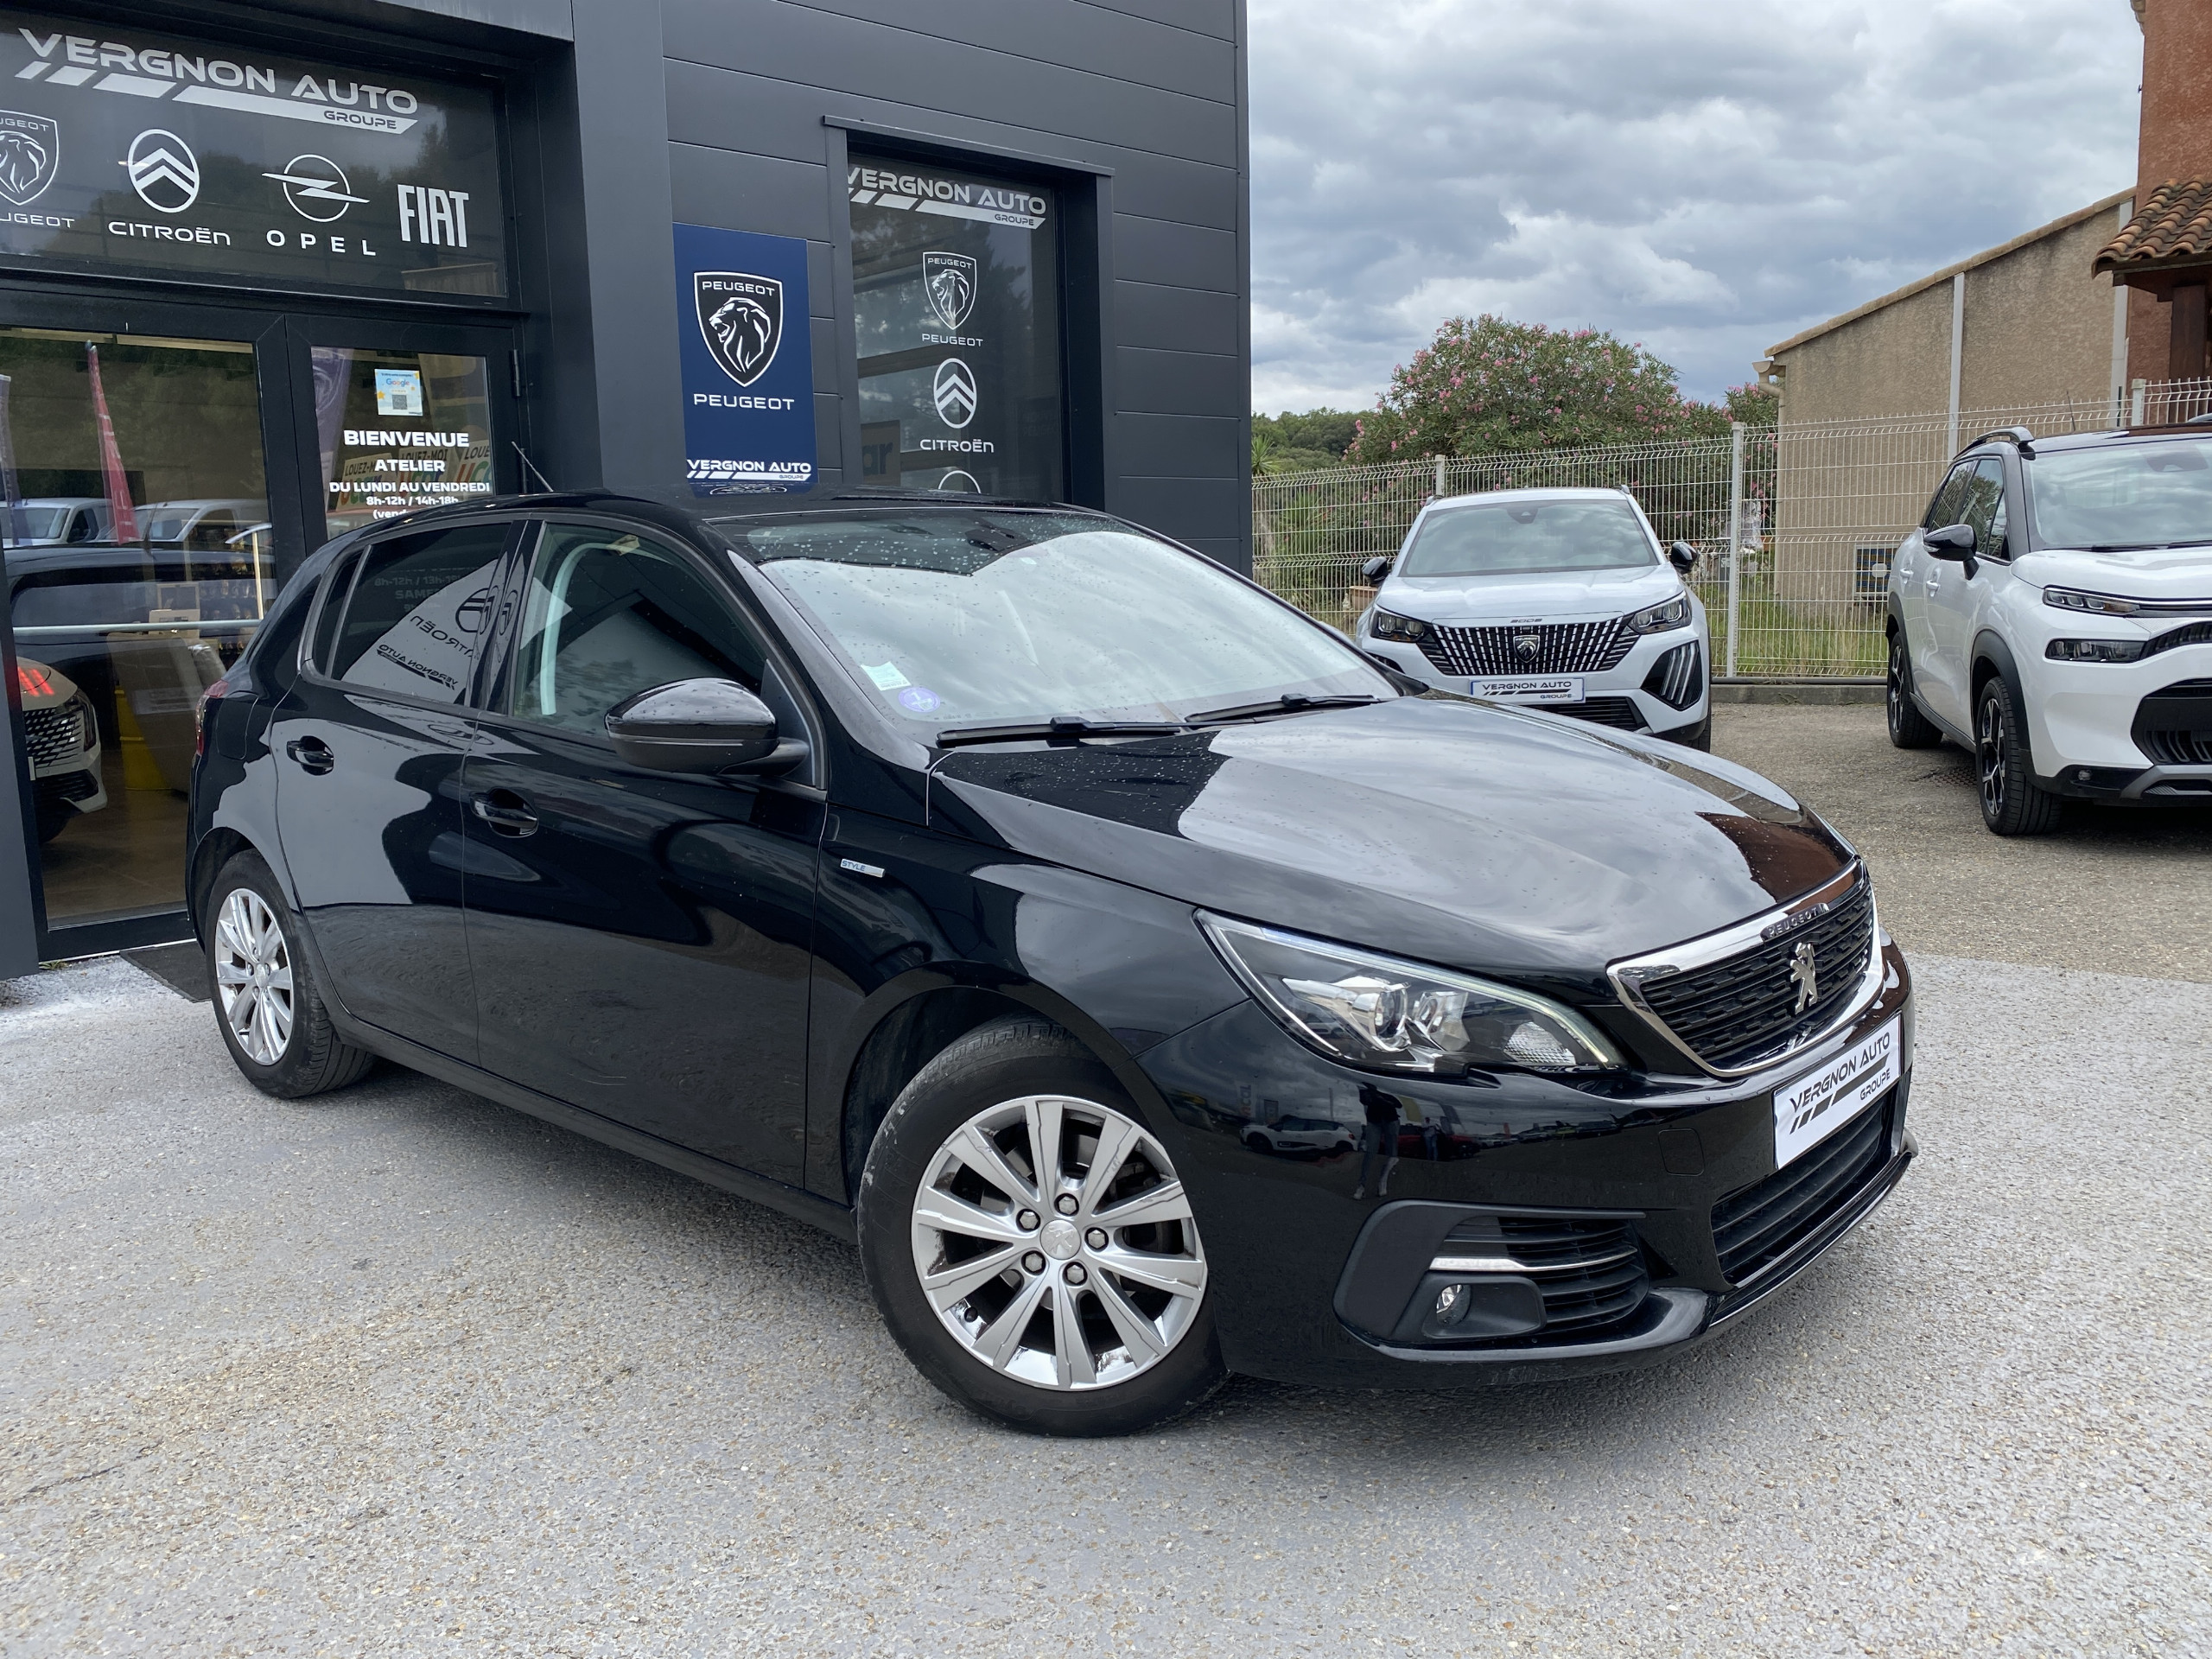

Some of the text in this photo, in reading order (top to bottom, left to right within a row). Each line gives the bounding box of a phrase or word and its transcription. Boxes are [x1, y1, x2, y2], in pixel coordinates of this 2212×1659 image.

[17, 27, 419, 114] VERGNON AUTO
[323, 109, 397, 130] GROUPE
[977, 188, 1046, 215] AUTO
[397, 183, 470, 249] FIAT
[994, 213, 1034, 226] GROUPE
[265, 228, 378, 257] OPEL
[927, 257, 972, 270] PEUGEOT
[702, 280, 776, 296] PEUGEOT
[921, 333, 983, 347] PEUGEOT
[385, 378, 410, 387] Google
[693, 393, 795, 410] PEUGEOT
[343, 429, 470, 448] BIENVENUE
[374, 459, 446, 473] ATELIER
[686, 459, 812, 473] VERGNON AUTO
[329, 481, 490, 493] DU LUNDI AU VENDREDI
[365, 496, 406, 506] 8h-12h
[407, 496, 413, 506] /
[1482, 682, 1537, 690] VERGNON
[842, 860, 867, 872] STYLE
[1768, 906, 1819, 938] PEUGEOT
[1789, 1031, 1891, 1113] VERGNON AUTO
[1859, 1067, 1891, 1101] GROUPE
